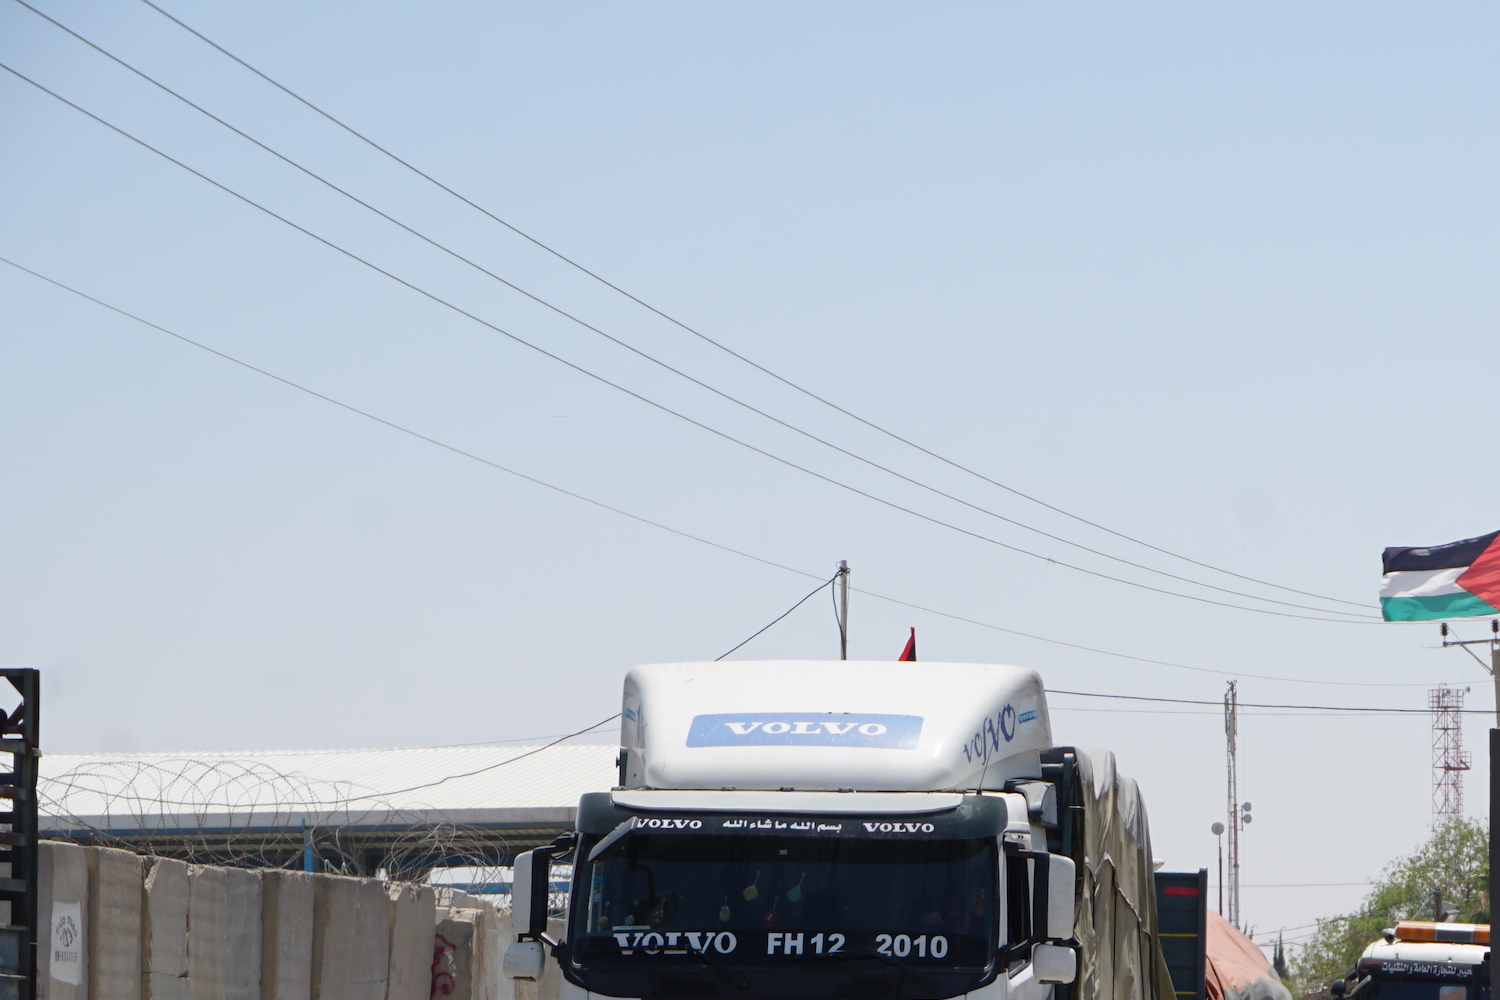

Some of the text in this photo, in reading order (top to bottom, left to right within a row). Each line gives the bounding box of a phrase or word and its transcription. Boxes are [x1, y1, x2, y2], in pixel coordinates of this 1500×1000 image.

[724, 721, 887, 735] VOLVO
[722, 818, 842, 833] بسم الله ما شاء الله
[863, 822, 935, 833] VOLVO
[613, 931, 737, 955] VOLVO
[875, 933, 949, 958] 2010
